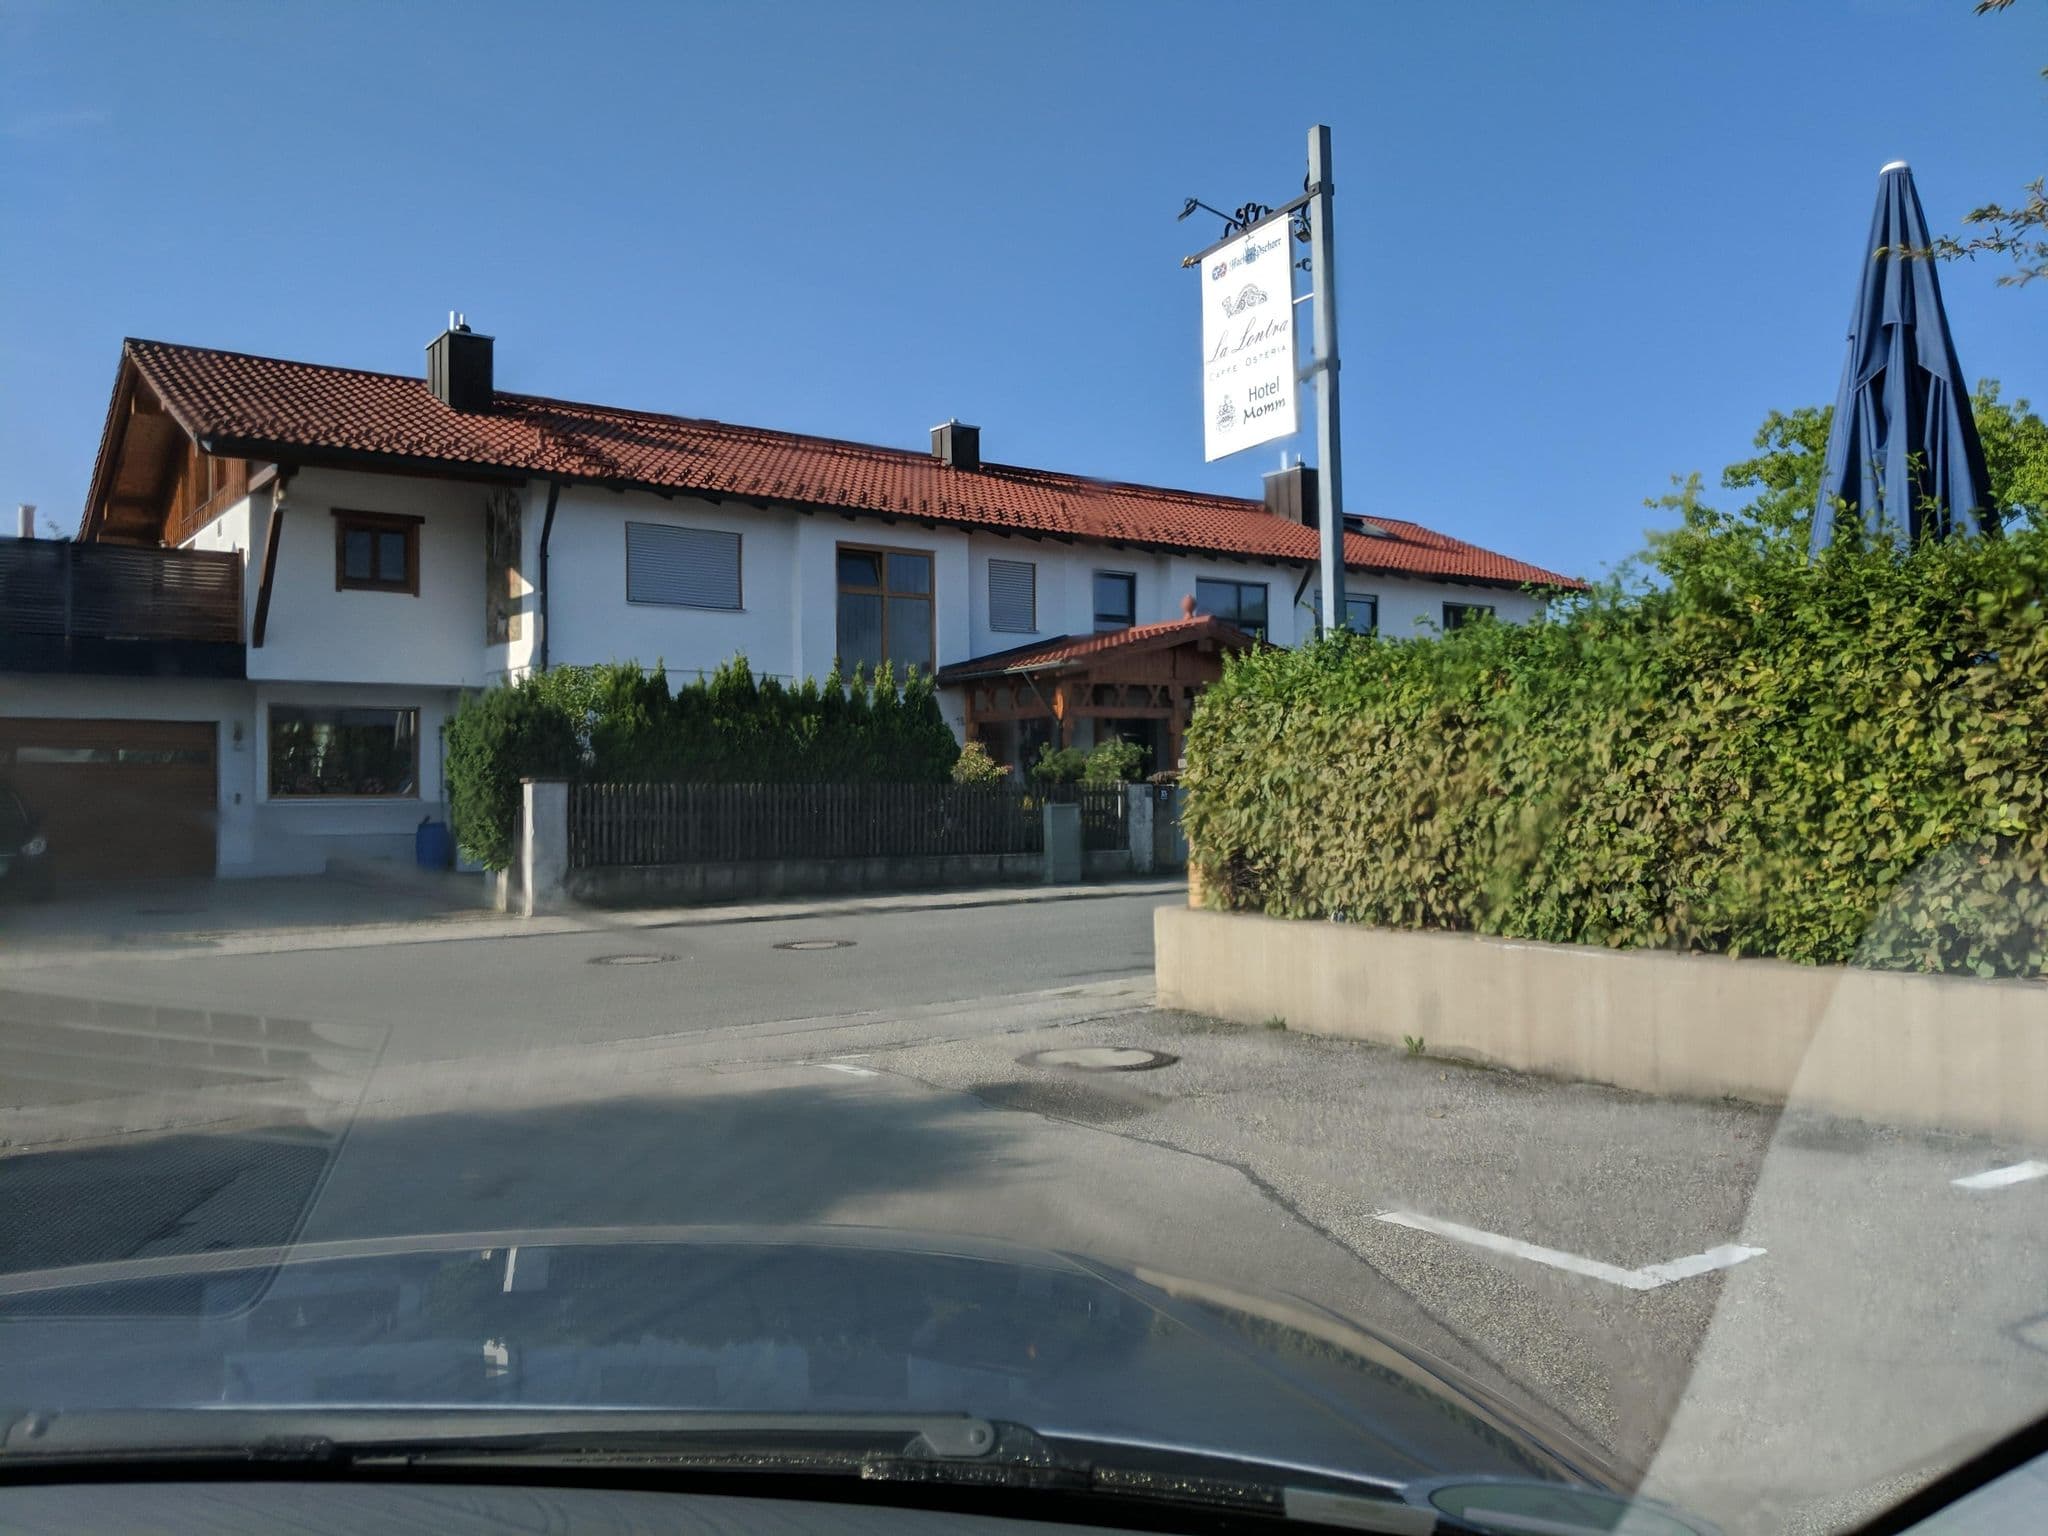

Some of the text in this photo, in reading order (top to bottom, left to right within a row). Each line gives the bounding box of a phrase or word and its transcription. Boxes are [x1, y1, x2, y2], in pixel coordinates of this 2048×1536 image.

[1208, 316, 1289, 363] La Lontra
[1245, 344, 1287, 366] OSTERIA
[1249, 376, 1280, 402] Hotel
[1243, 398, 1286, 424] Momm
